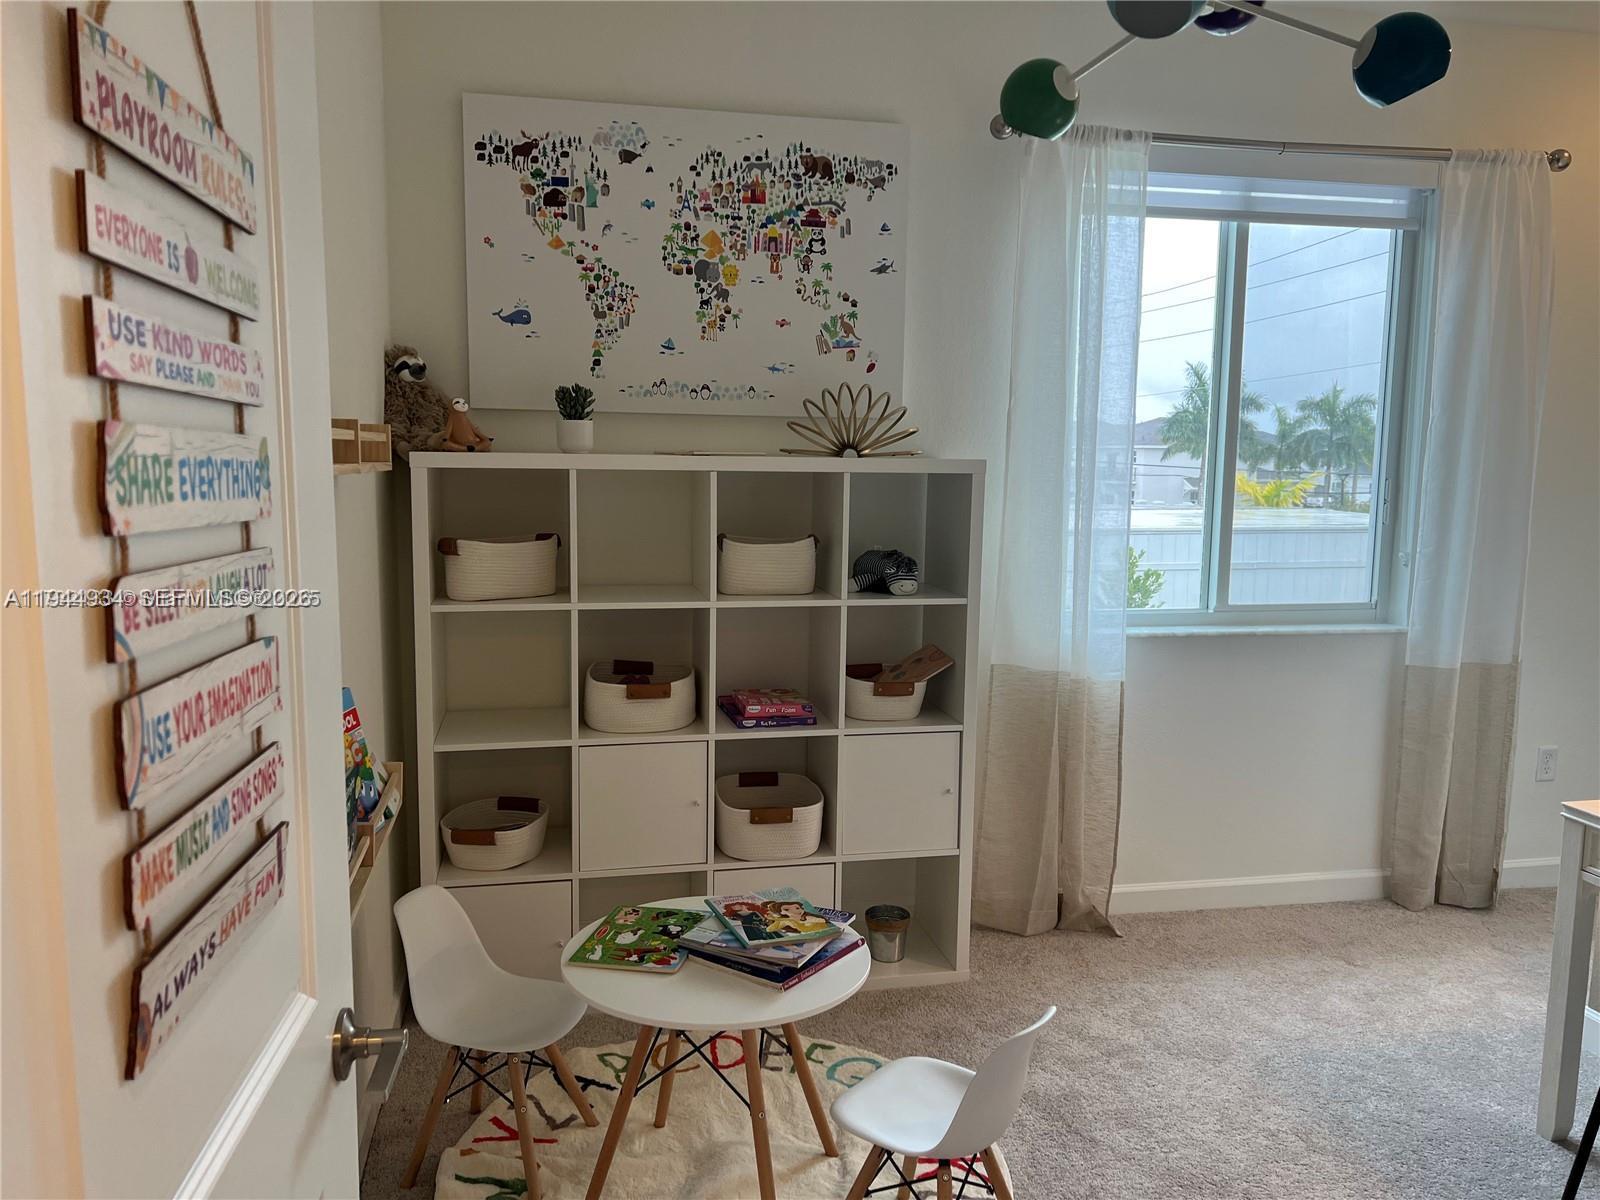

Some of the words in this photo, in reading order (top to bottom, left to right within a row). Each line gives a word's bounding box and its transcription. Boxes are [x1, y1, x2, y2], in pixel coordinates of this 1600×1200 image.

[95, 69, 198, 184] PLAYROOM
[201, 152, 245, 221] RULES
[95, 203, 164, 266] EVERYONE
[166, 240, 181, 274] IS
[203, 257, 259, 310] WELCOME
[107, 308, 147, 348] USE
[151, 321, 194, 360] KIND
[197, 336, 248, 375] WORDS
[129, 352, 153, 376] SAY
[155, 357, 195, 385] PLEASE
[196, 368, 216, 388] AND
[244, 380, 261, 398] YOU
[113, 452, 175, 508] SHARE
[178, 454, 262, 502] EVERYTHING
[145, 711, 172, 765] USE
[173, 690, 206, 749] YOUR
[207, 656, 273, 728] IMAGINATION
[138, 841, 174, 906] MAKE
[175, 811, 210, 876] MUSIC
[211, 794, 231, 844] AND
[231, 777, 252, 825] SING
[252, 756, 278, 806] SONGS
[151, 935, 216, 1023] ALWAYS
[218, 892, 252, 946] HAVE
[254, 862, 277, 906] FUN
